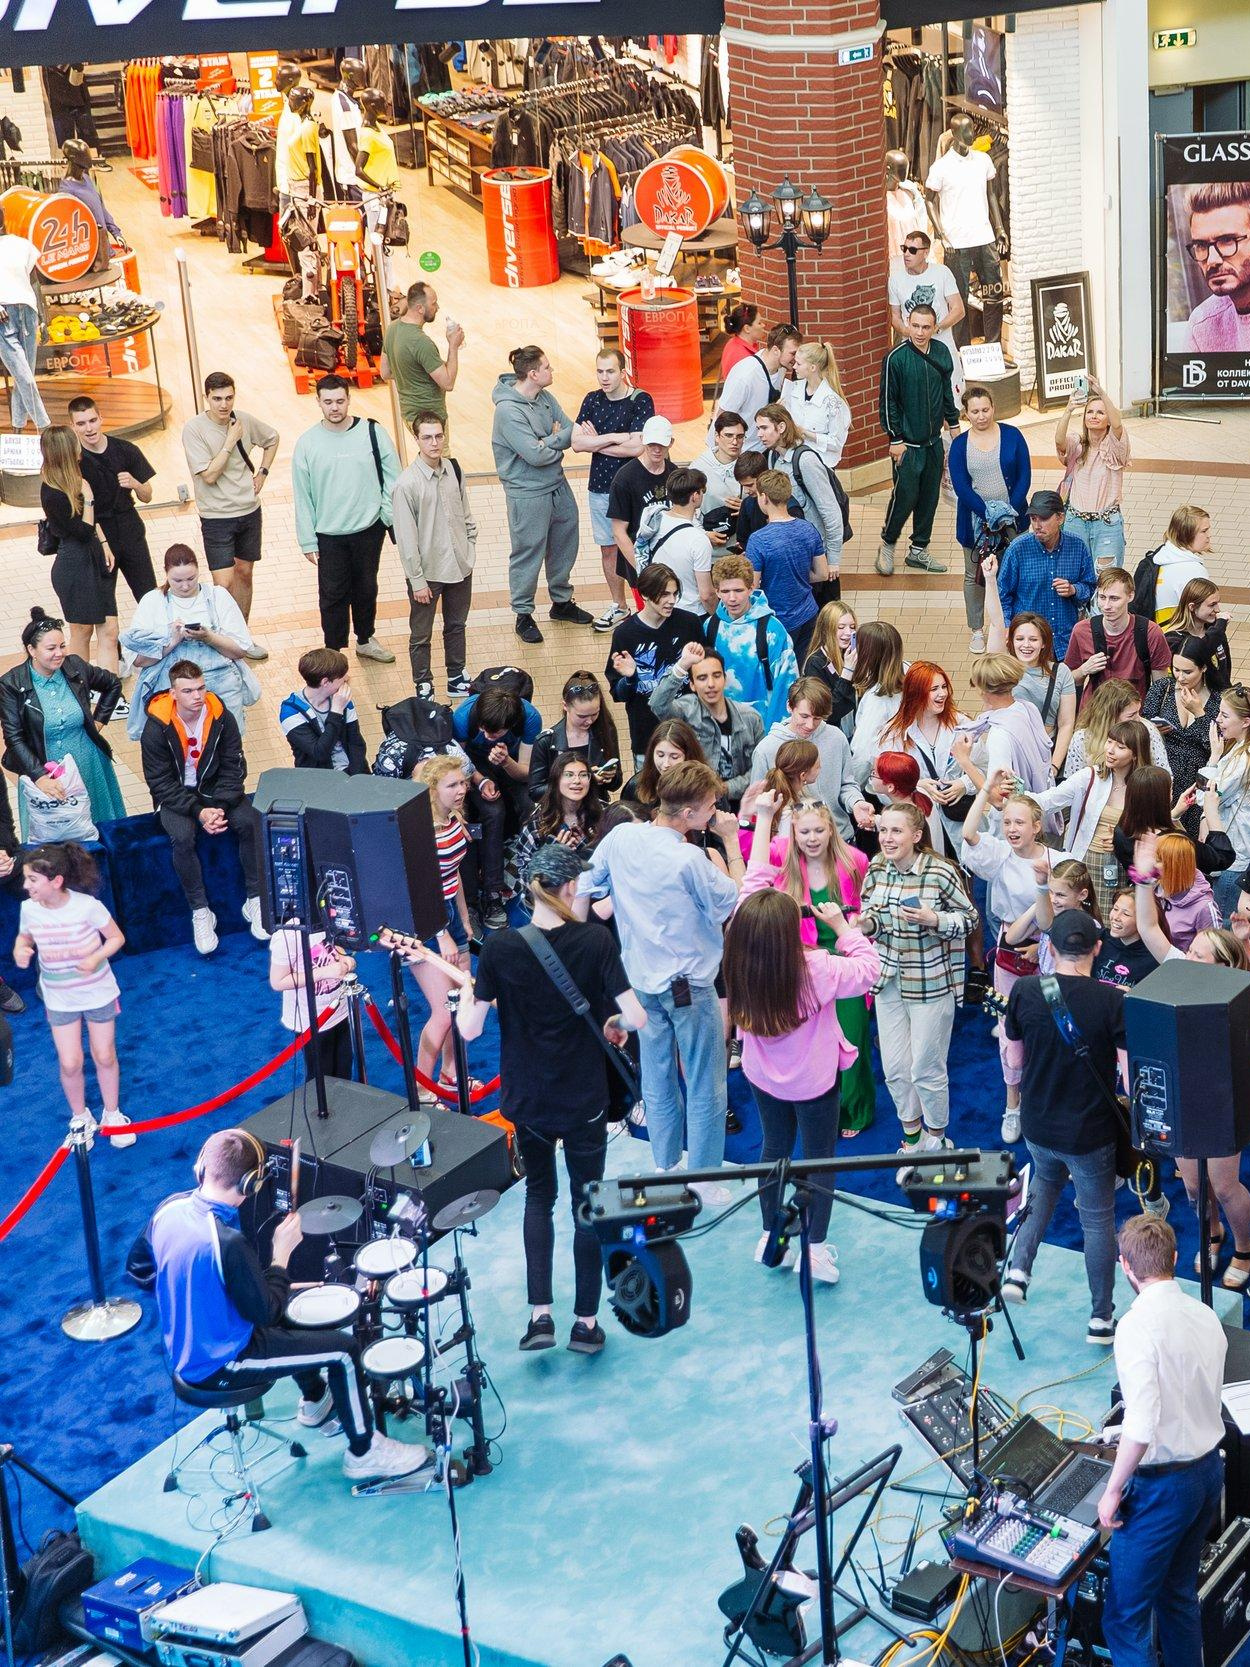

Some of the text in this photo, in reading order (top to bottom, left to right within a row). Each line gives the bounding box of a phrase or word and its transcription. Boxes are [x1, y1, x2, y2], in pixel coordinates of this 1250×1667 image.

[258, 67, 274, 88] 2
[653, 204, 697, 225] DAKAR
[41, 208, 91, 253] 24h
[500, 184, 520, 288] diverse
[645, 310, 695, 322] ЕВРОПА
[1046, 338, 1083, 360] DAKAR
[45, 353, 102, 370] ЕВРОПА
[1049, 383, 1075, 392] PRODU
[1050, 375, 1081, 385] OFFICI
[1217, 380, 1229, 388] ОТ
[643, 490, 654, 503] ALL
[1103, 959, 1115, 970] I
